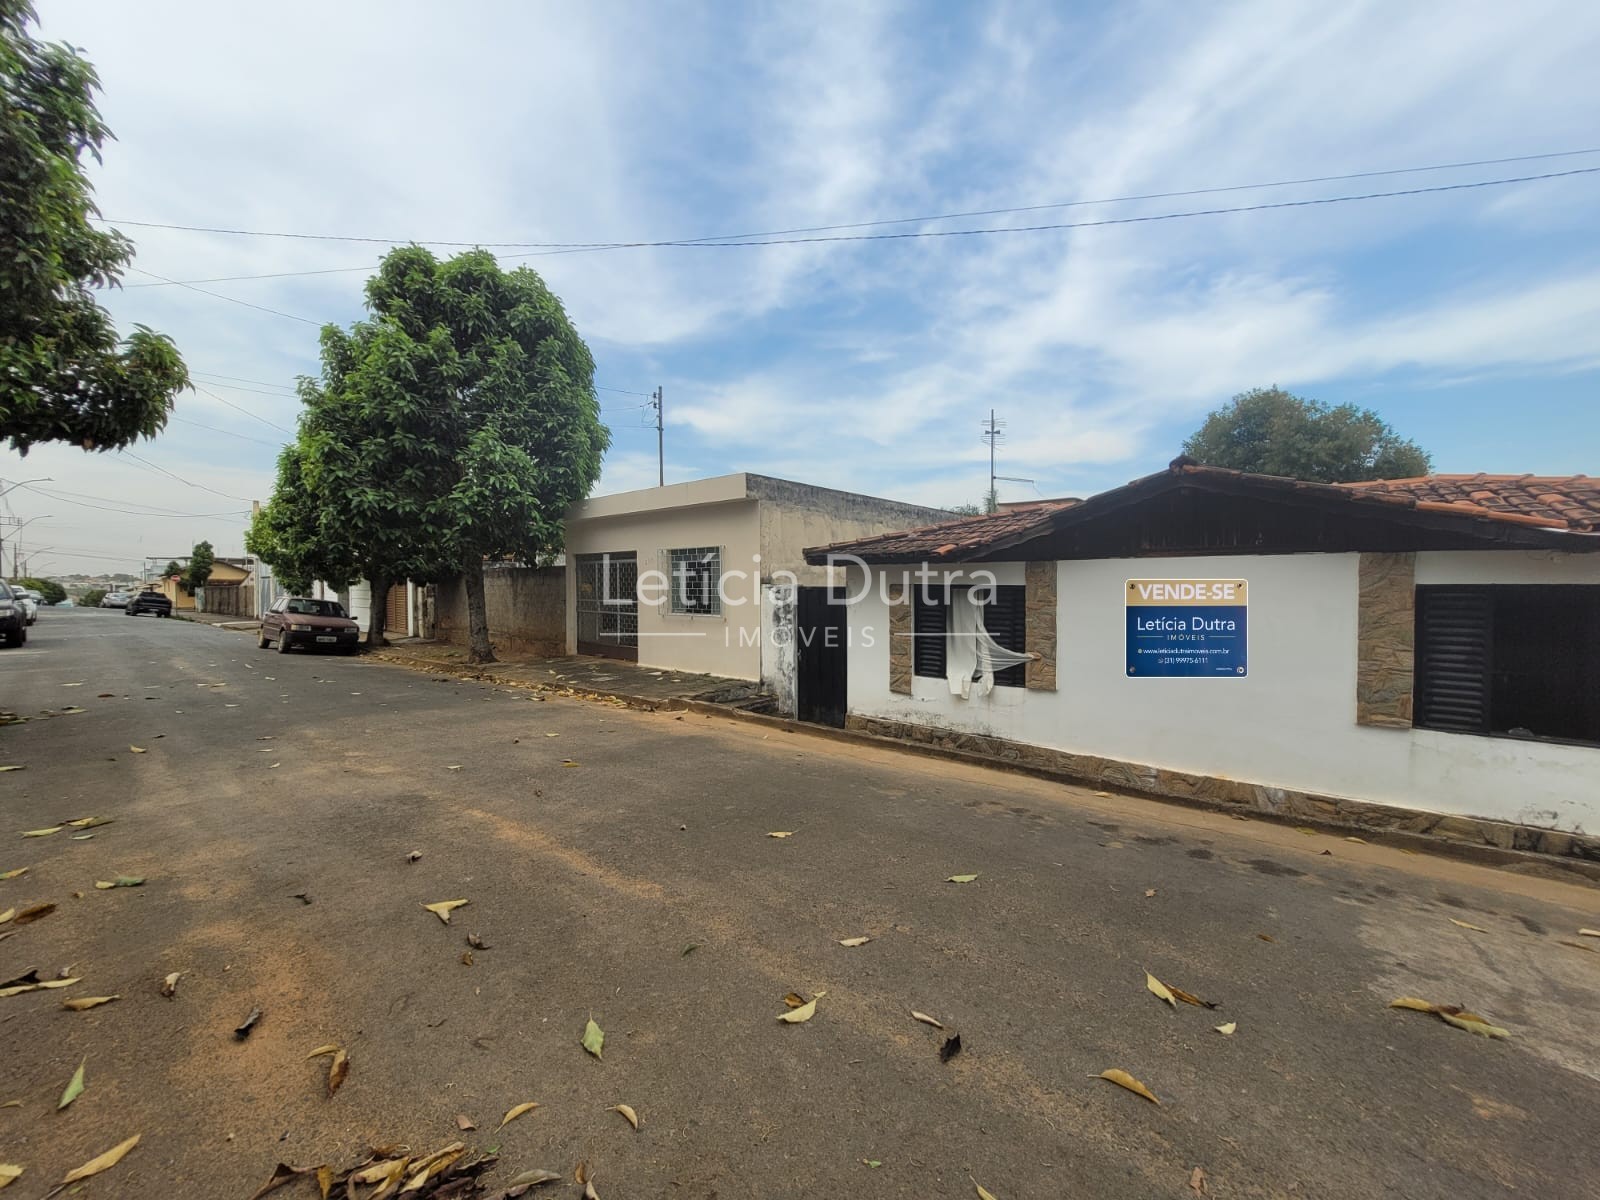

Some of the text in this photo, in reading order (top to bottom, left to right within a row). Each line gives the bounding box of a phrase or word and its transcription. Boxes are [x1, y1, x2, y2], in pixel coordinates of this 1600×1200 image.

[1138, 583, 1235, 600] VENDE-SE
[1137, 616, 1235, 631] Letícia Dutra
